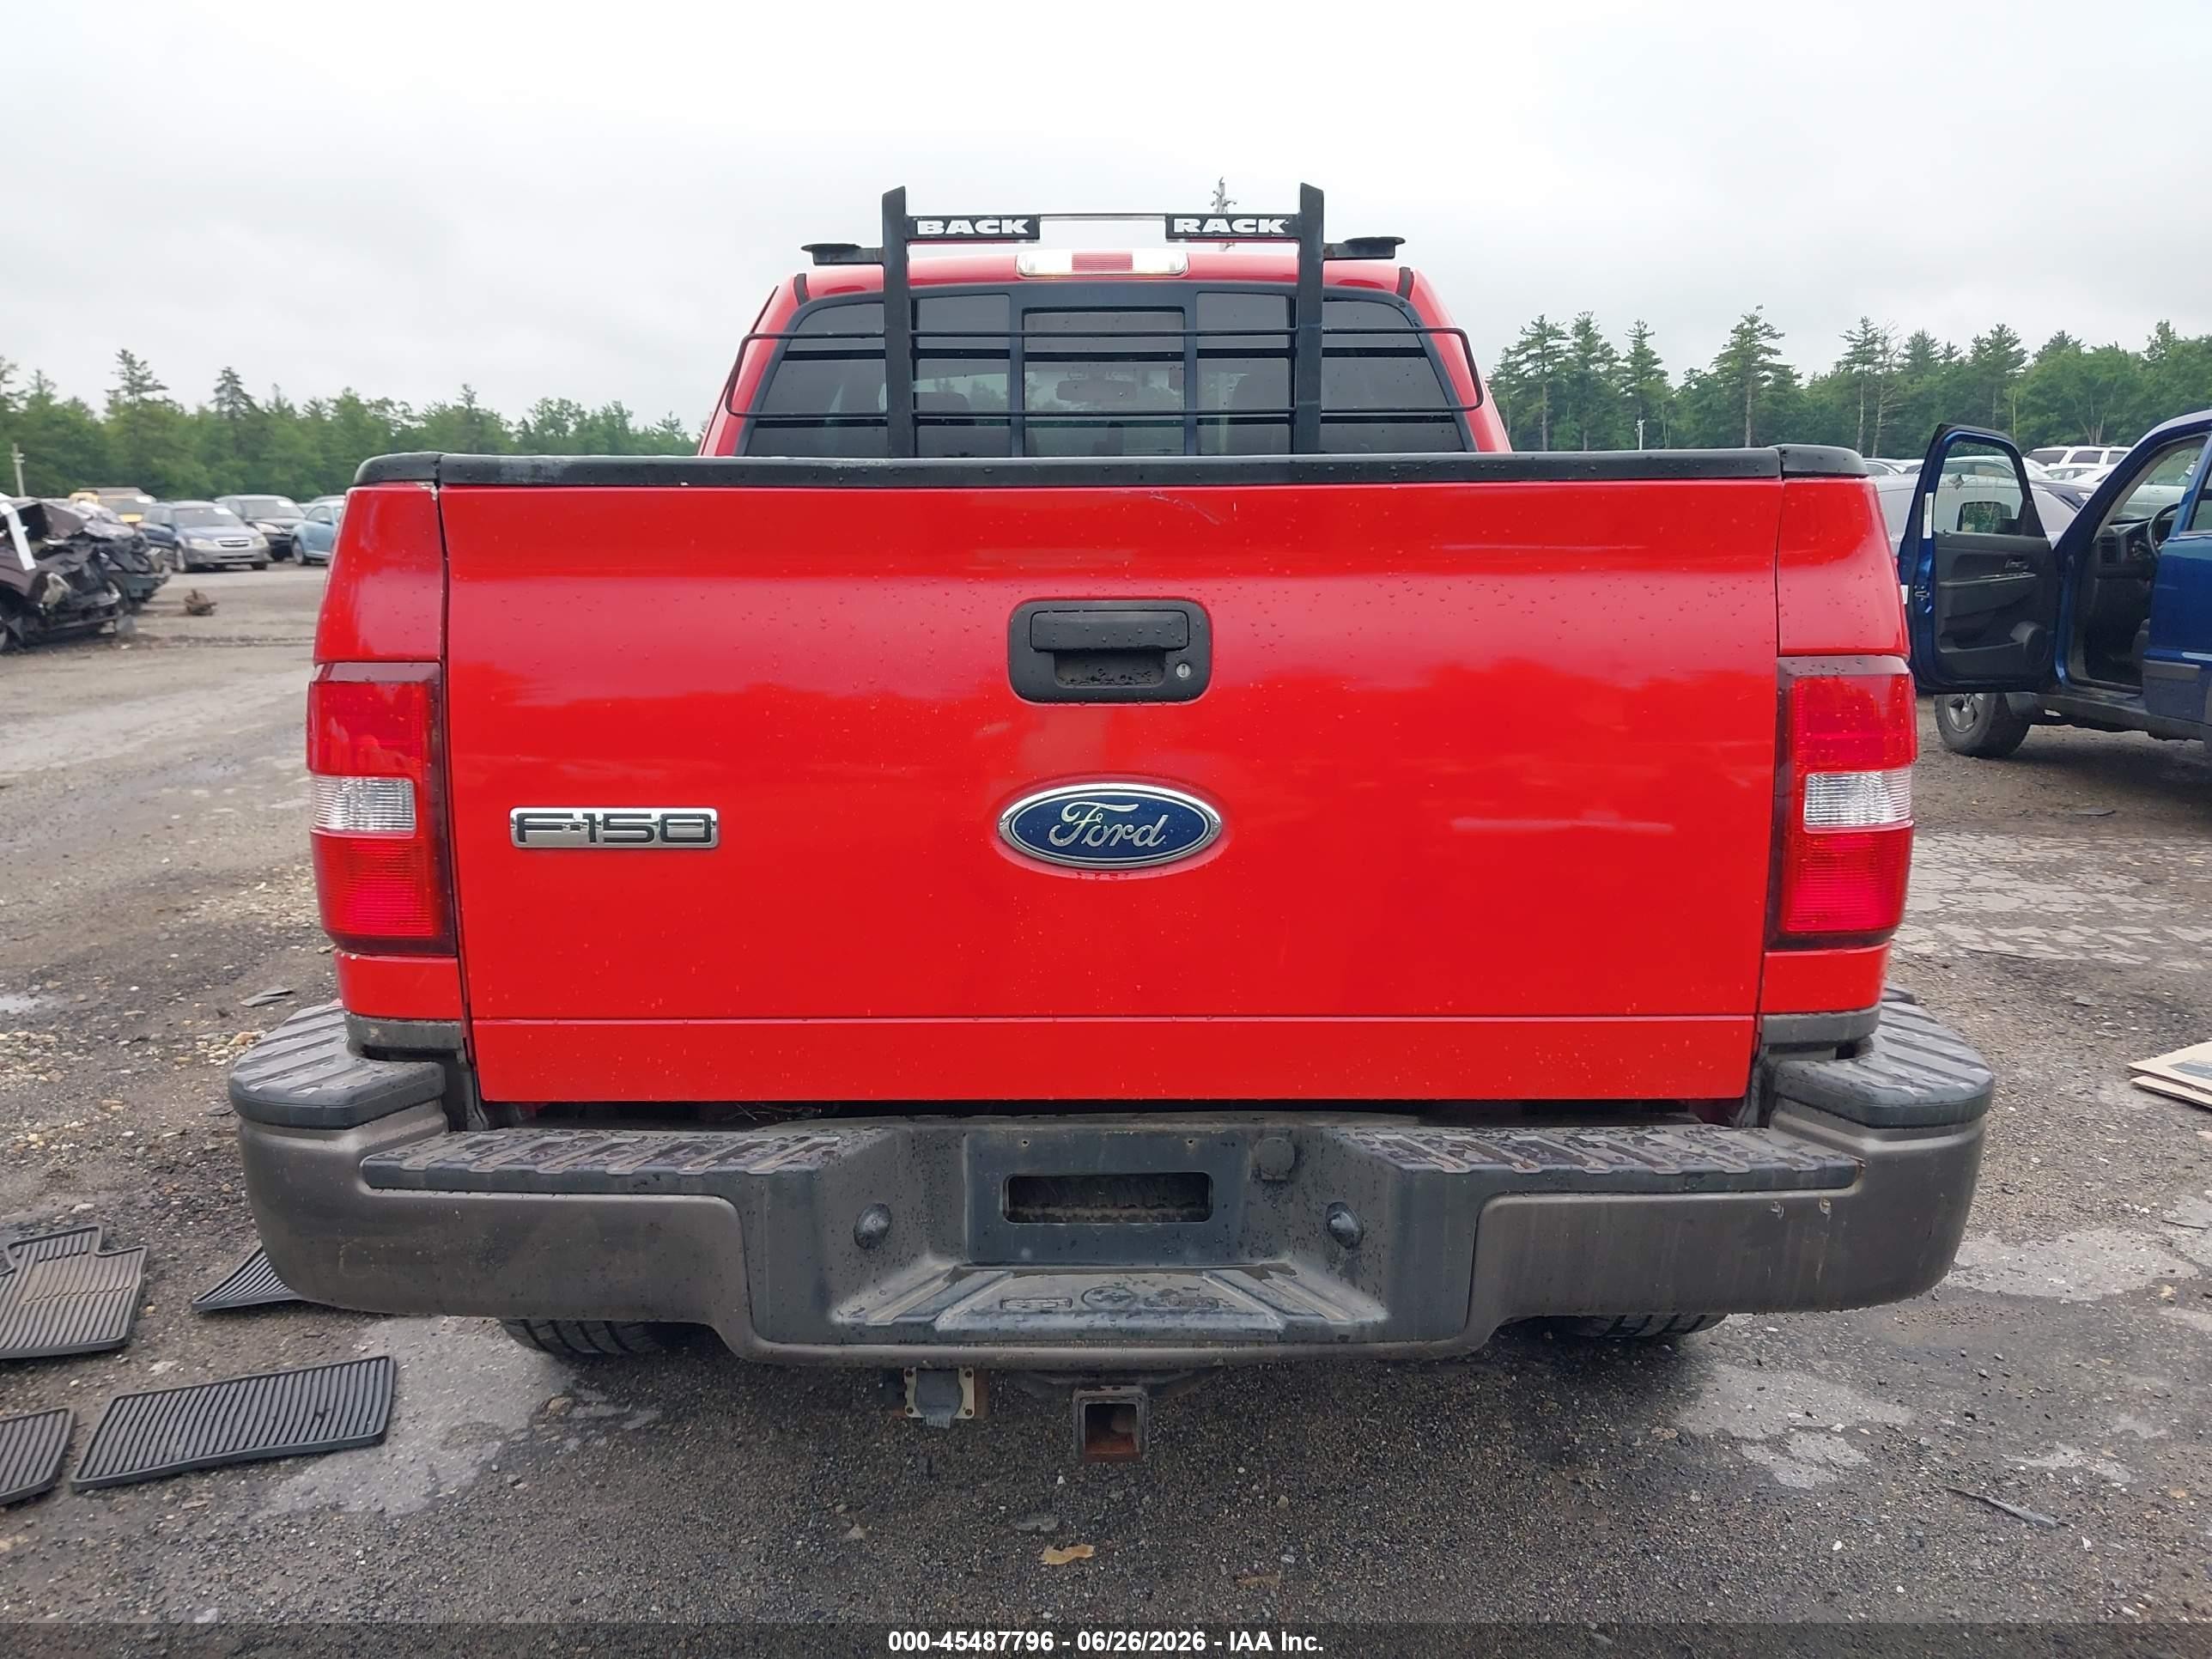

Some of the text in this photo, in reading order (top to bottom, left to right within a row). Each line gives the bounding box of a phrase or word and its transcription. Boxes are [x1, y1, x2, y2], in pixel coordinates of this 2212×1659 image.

[916, 218, 1286, 235] BACK RACK
[515, 812, 713, 843] F-150
[1048, 801, 1169, 848] Ford
